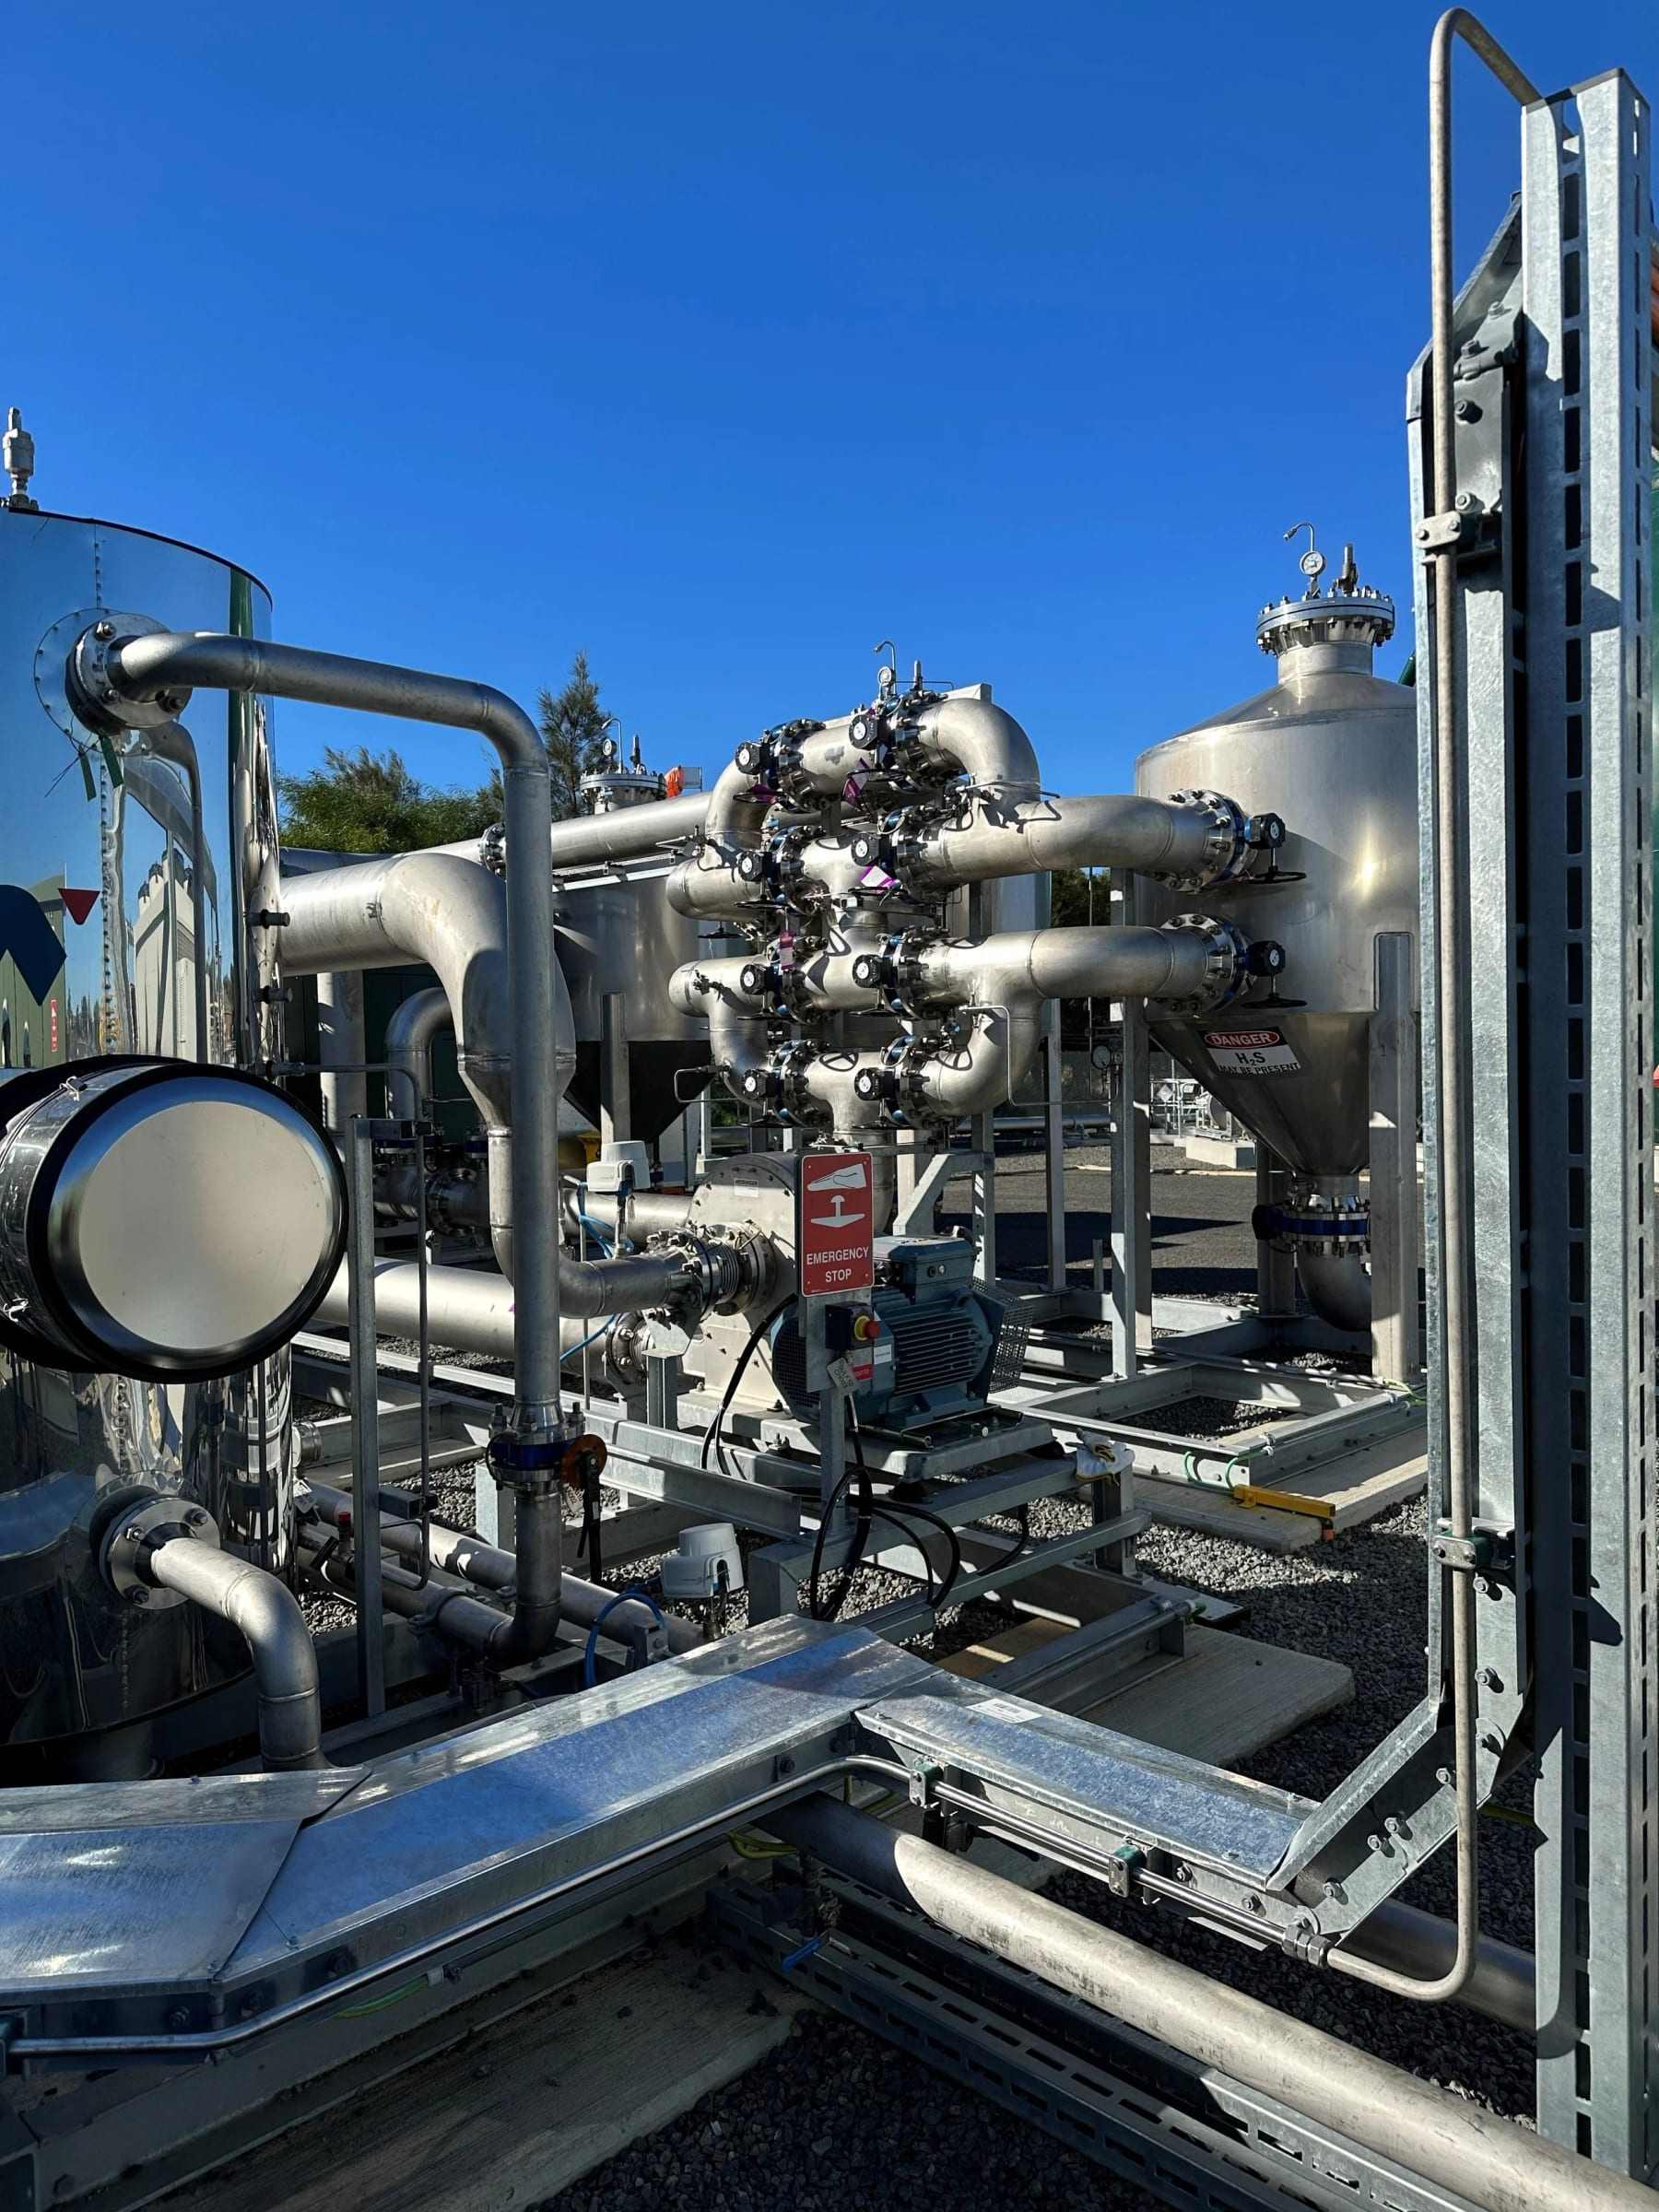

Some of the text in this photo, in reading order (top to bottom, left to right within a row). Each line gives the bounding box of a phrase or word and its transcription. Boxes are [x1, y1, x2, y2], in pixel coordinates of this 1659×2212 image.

[1211, 1032, 1271, 1047] DANGER
[1217, 1062, 1300, 1075] MAY BE PRESENT
[806, 1246, 869, 1265] EMERGENCY
[825, 1268, 852, 1283] STOP
